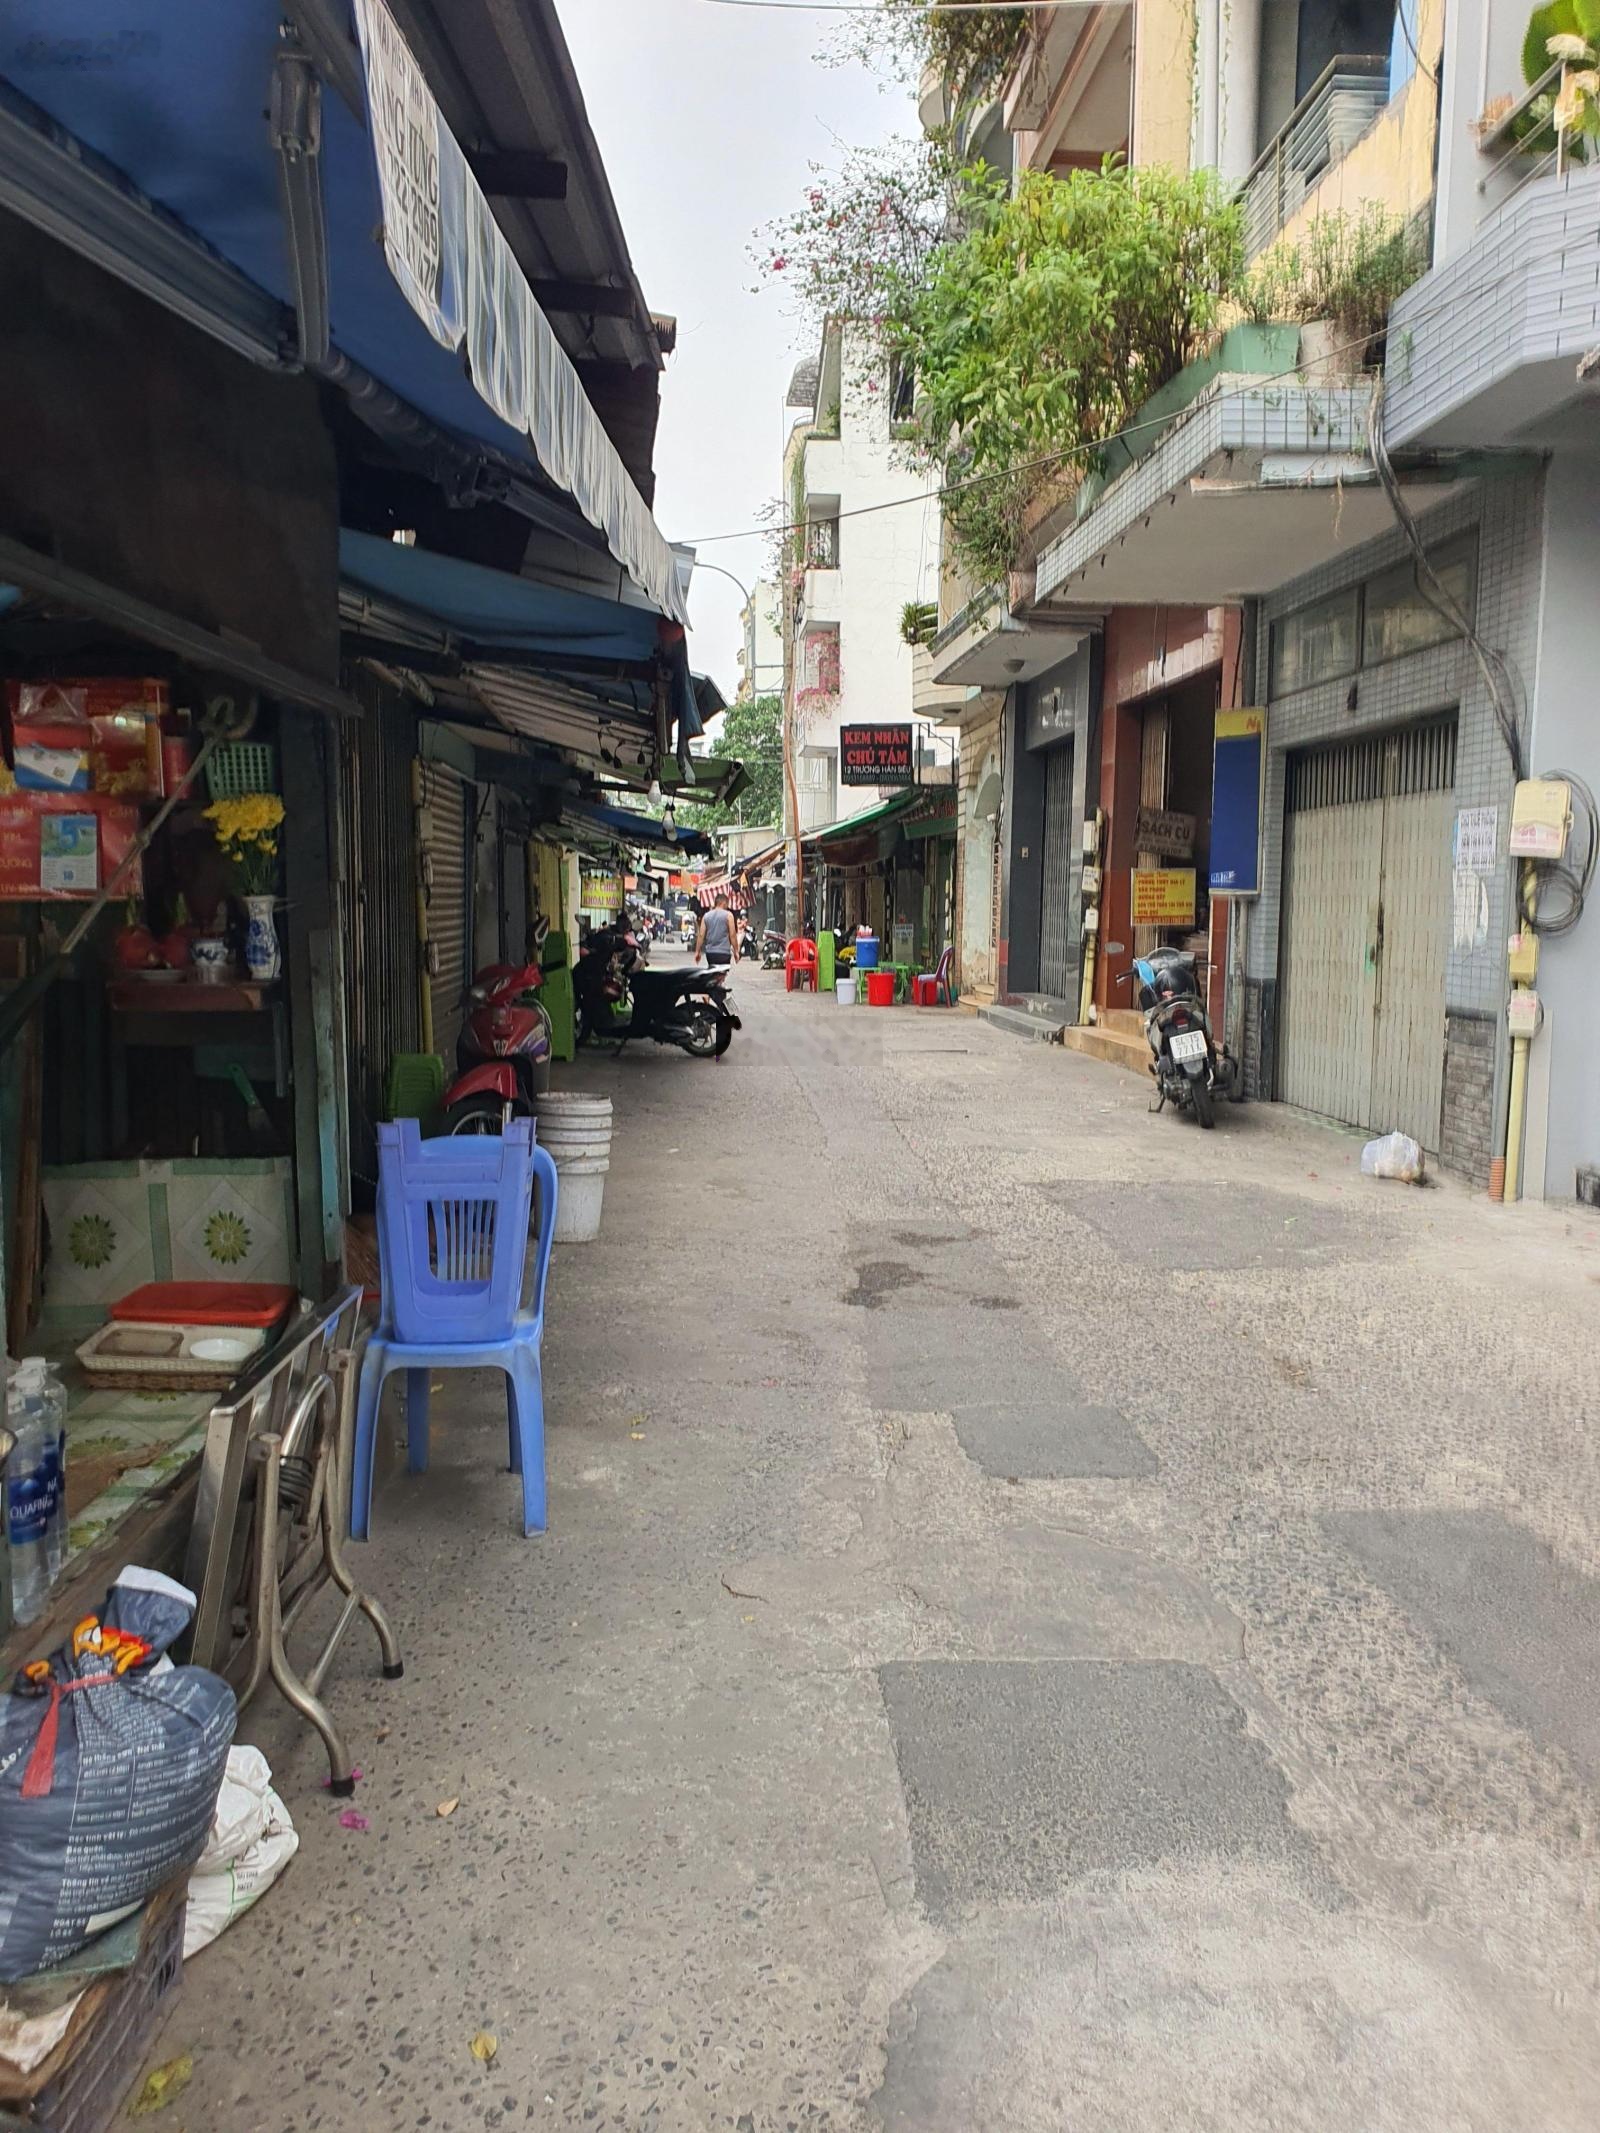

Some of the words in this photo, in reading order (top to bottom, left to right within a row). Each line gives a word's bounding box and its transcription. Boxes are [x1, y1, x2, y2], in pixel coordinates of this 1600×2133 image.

[845, 731, 871, 745] KEM
[847, 746, 875, 765] CHÚ
[878, 746, 908, 765] TÁM
